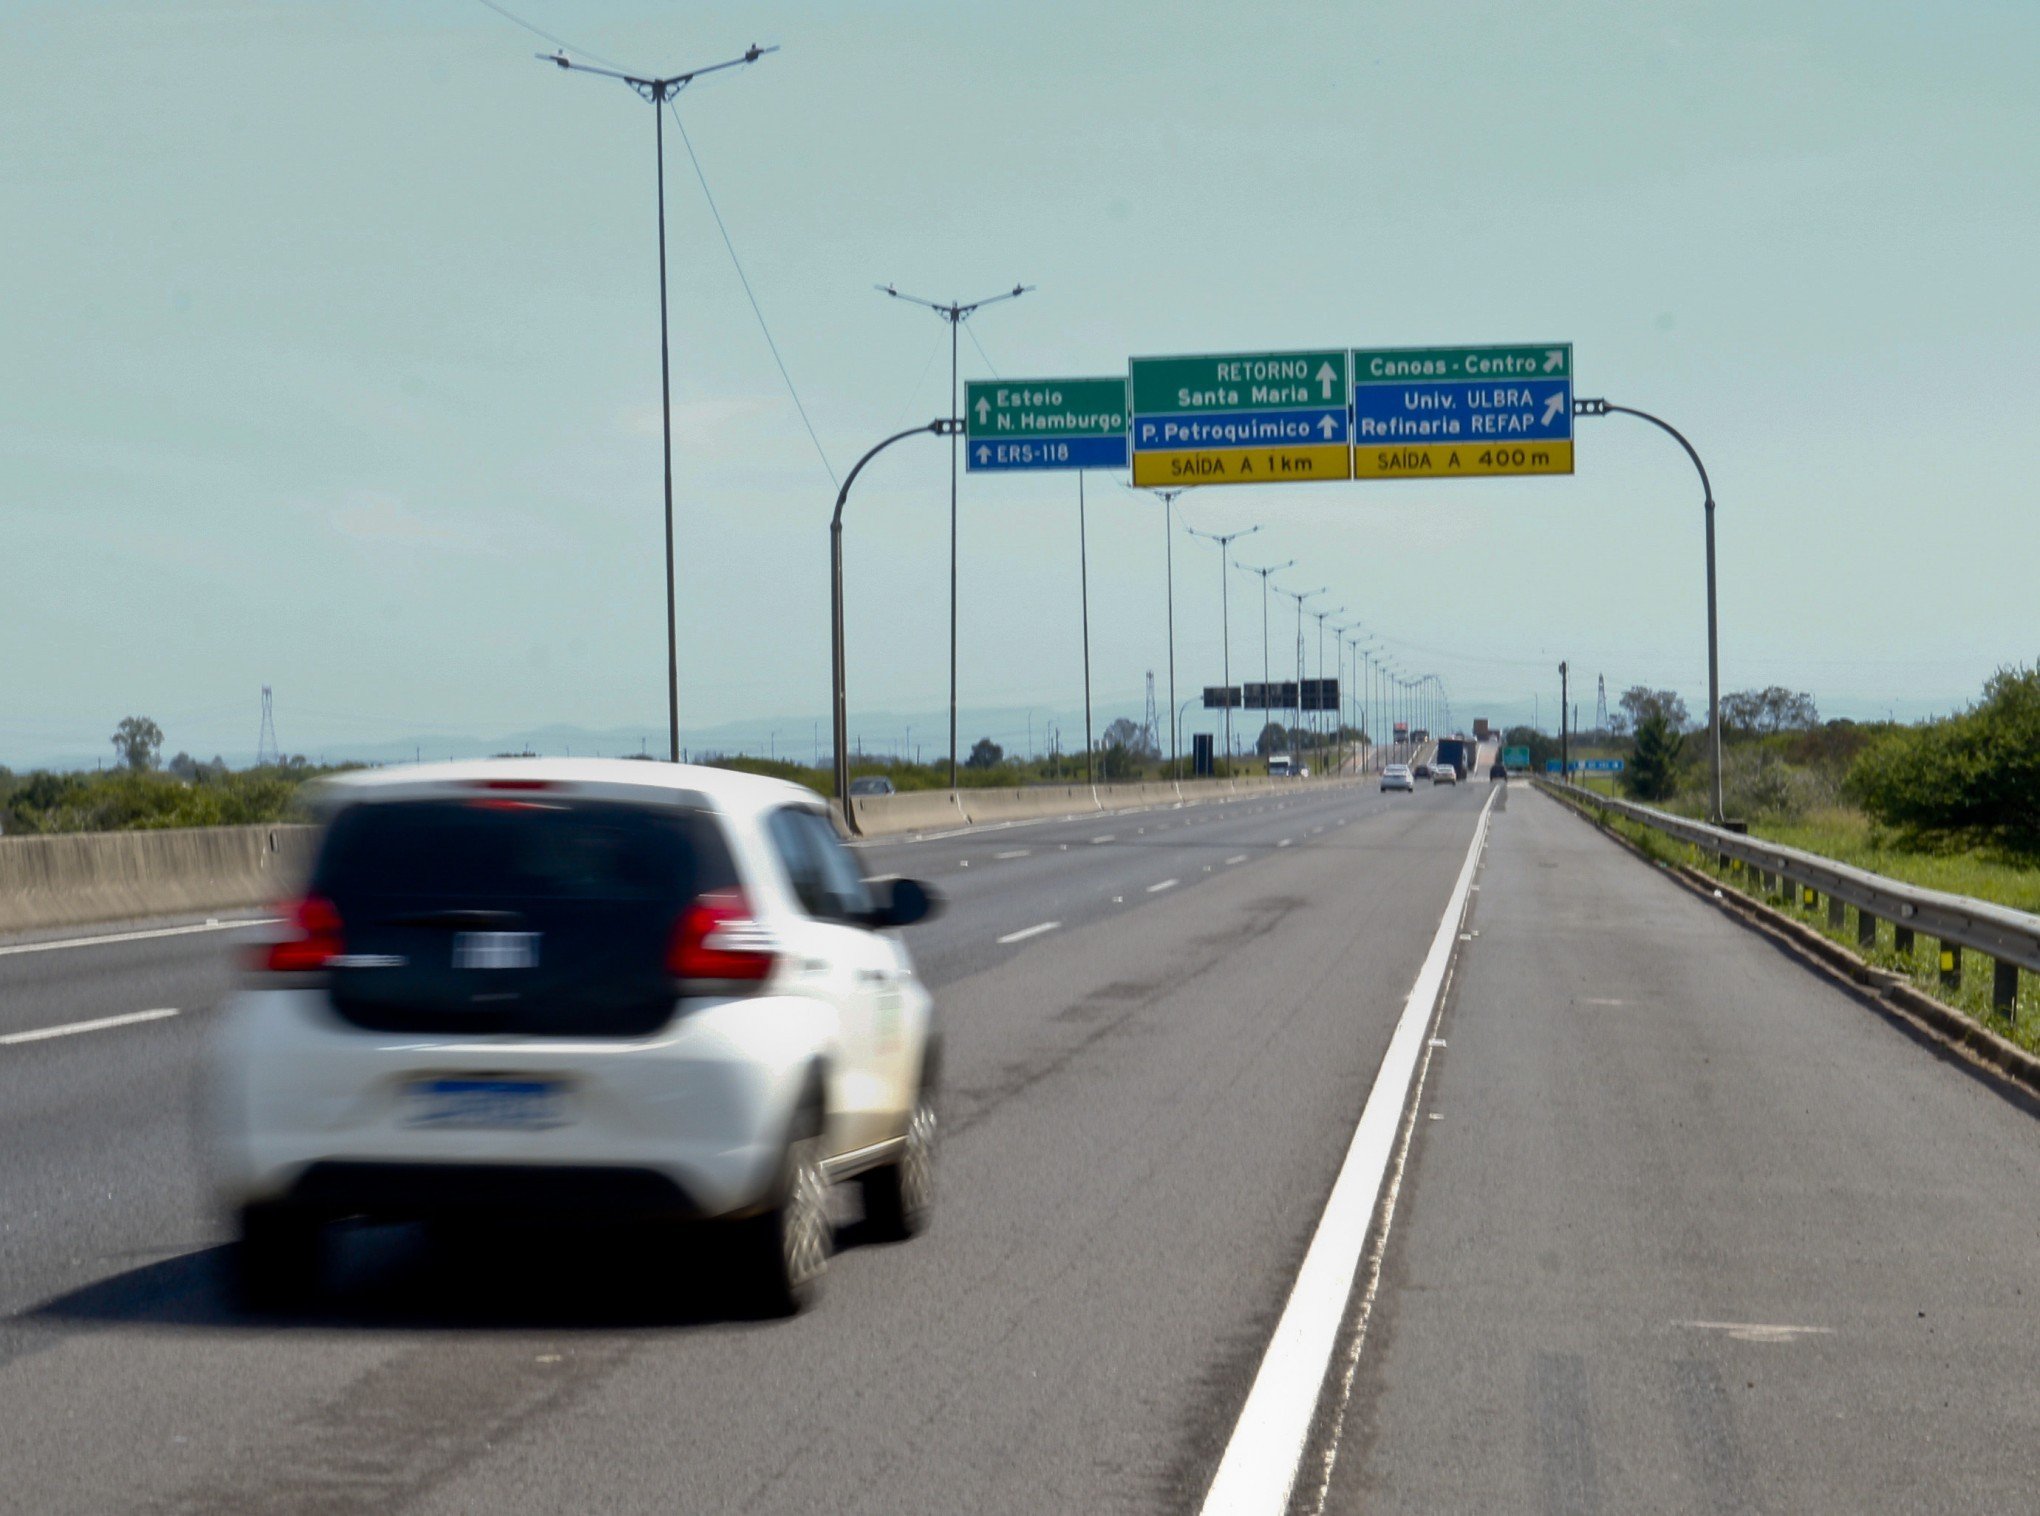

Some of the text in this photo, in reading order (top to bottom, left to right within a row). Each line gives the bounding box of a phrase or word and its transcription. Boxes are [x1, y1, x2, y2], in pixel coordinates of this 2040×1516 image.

[1216, 360, 1308, 382] RETORNO
[1370, 357, 1447, 377] Canoas
[1465, 354, 1537, 373] Centro
[996, 389, 1063, 408] Esteio
[1178, 384, 1309, 408] Santa Maria
[1405, 388, 1534, 410] Univ. ULBRA
[997, 411, 1122, 433] N. Hamburgo
[1142, 419, 1311, 443] P. Petroquímico
[1361, 413, 1535, 437] Refinaria REFAP
[997, 443, 1070, 463] ERS-118
[1171, 450, 1225, 476] SAÍDA
[1240, 455, 1253, 473] A
[1377, 447, 1432, 470] SAÍDA
[1448, 451, 1461, 468] A
